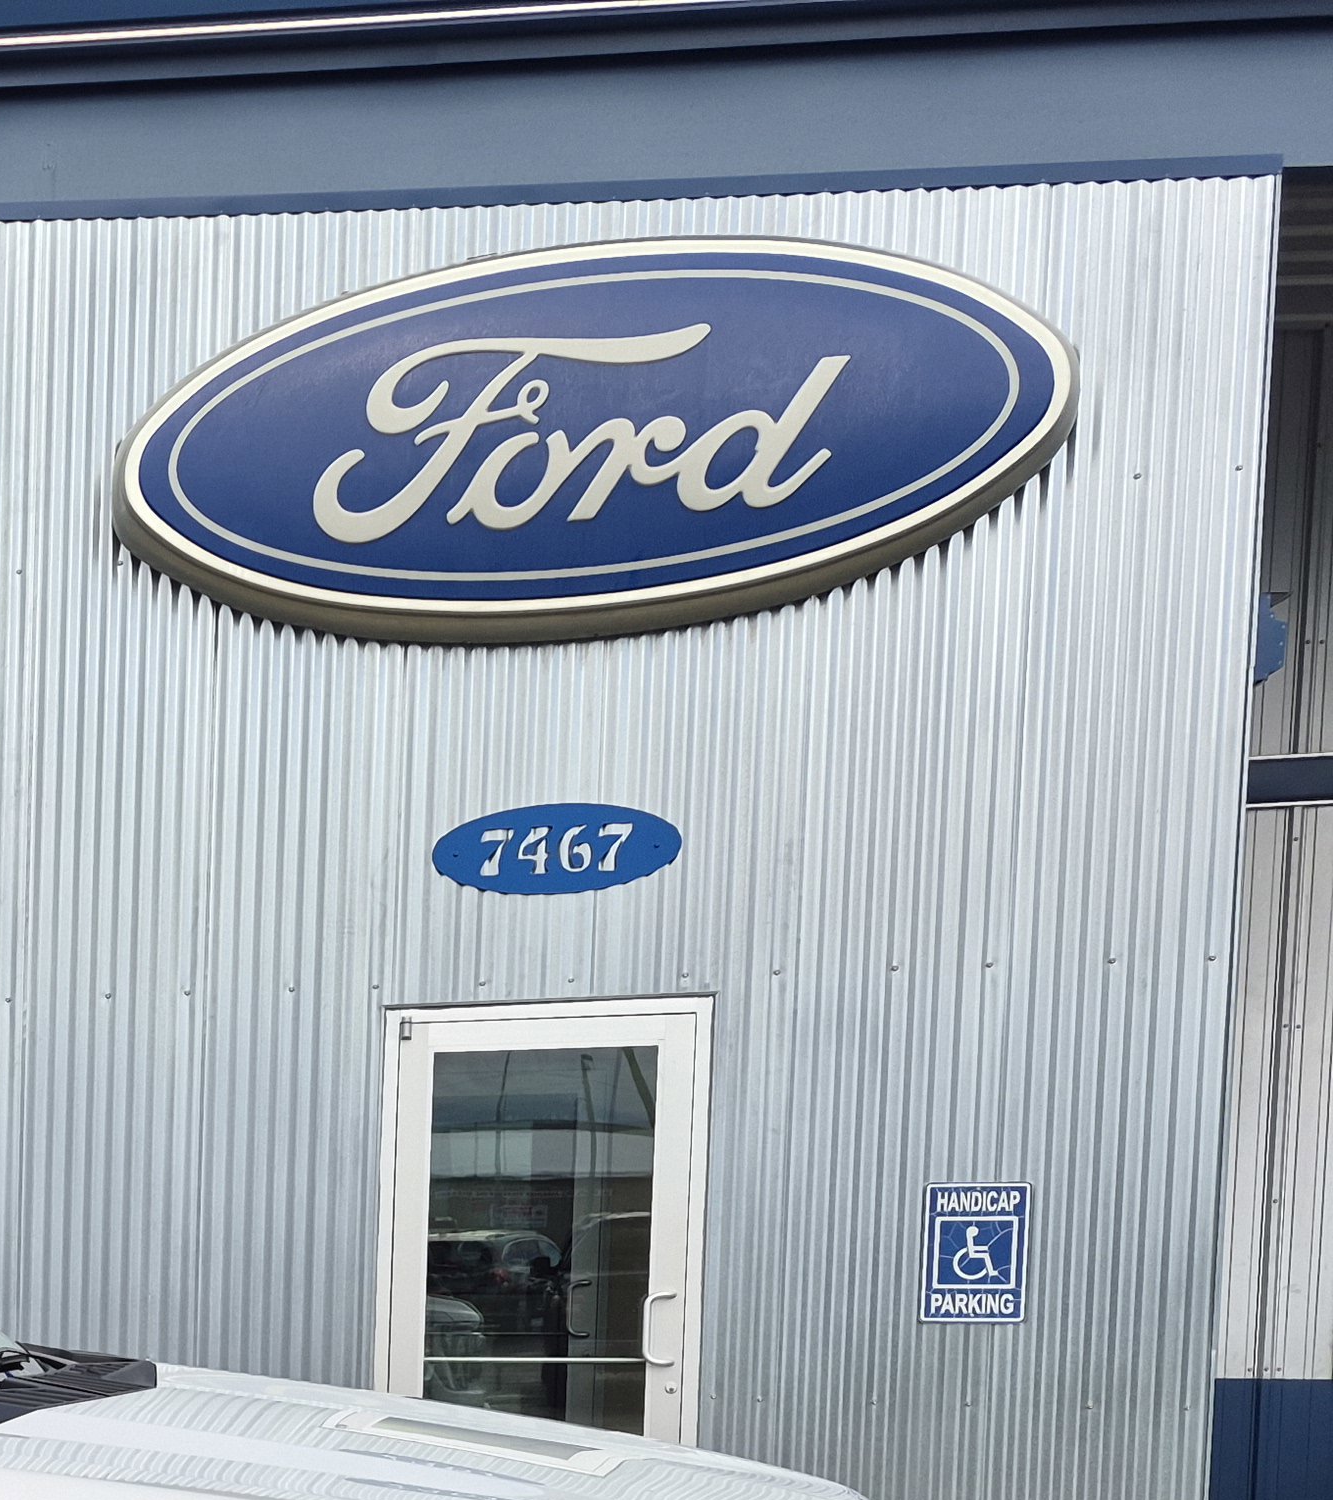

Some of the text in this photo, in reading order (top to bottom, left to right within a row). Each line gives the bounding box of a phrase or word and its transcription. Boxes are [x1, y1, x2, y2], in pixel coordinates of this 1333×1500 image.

[314, 322, 852, 544] Ford
[479, 822, 634, 877] 7467
[936, 1190, 1021, 1212] HANDICAP
[929, 1292, 1015, 1316] PARKING
